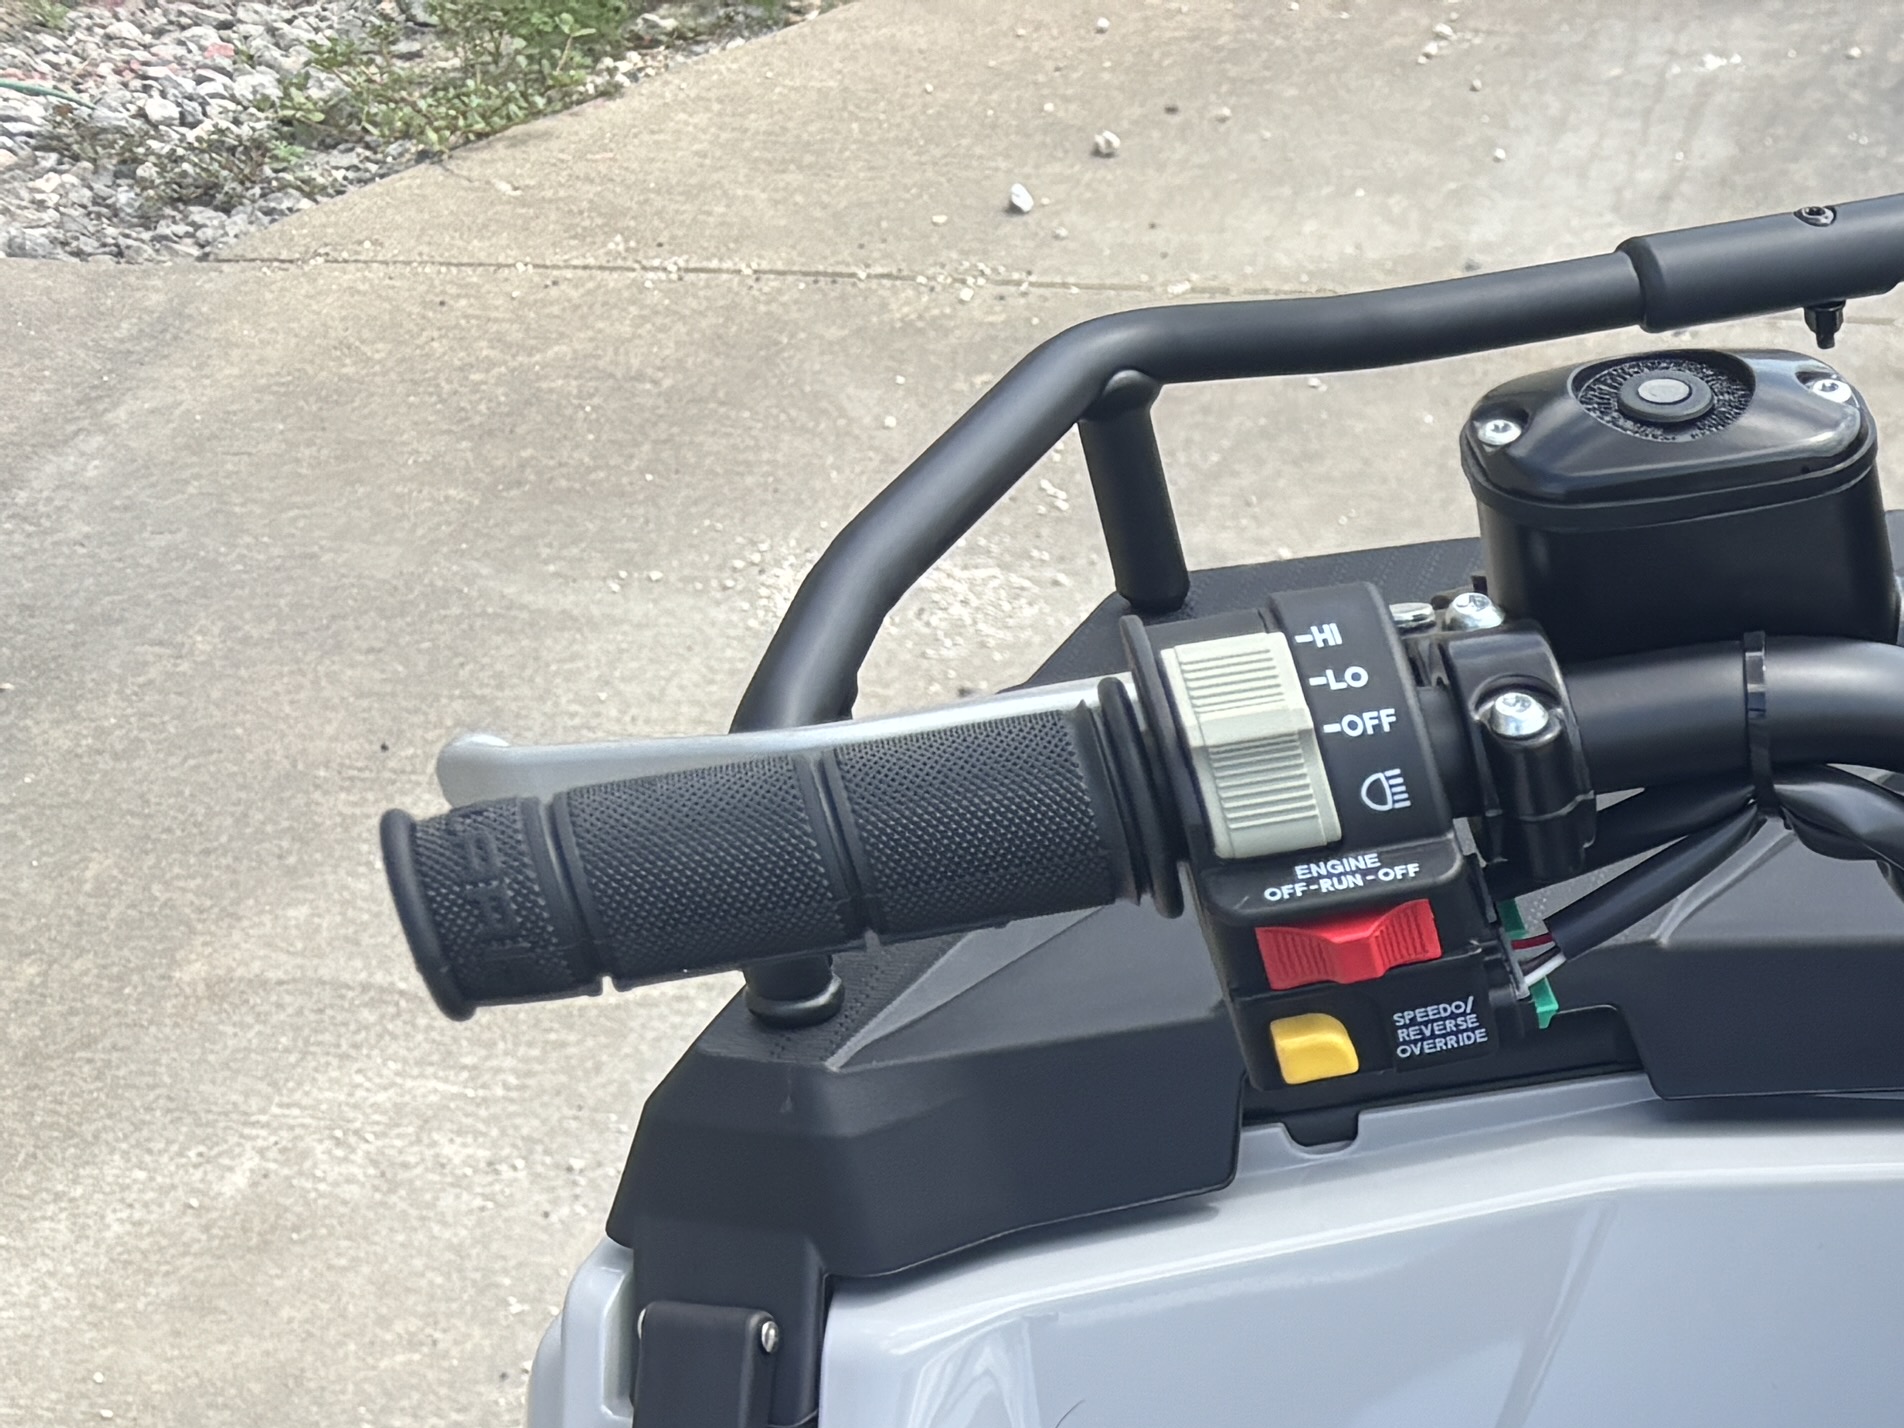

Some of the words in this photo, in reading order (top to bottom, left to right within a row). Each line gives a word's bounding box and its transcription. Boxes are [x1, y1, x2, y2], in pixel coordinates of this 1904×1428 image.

[1294, 853, 1381, 878] ENGINE
[1393, 996, 1474, 1027] SPEEDO/
[1398, 1014, 1480, 1042] REVERSE
[1397, 1029, 1488, 1058] OVERRIDE
